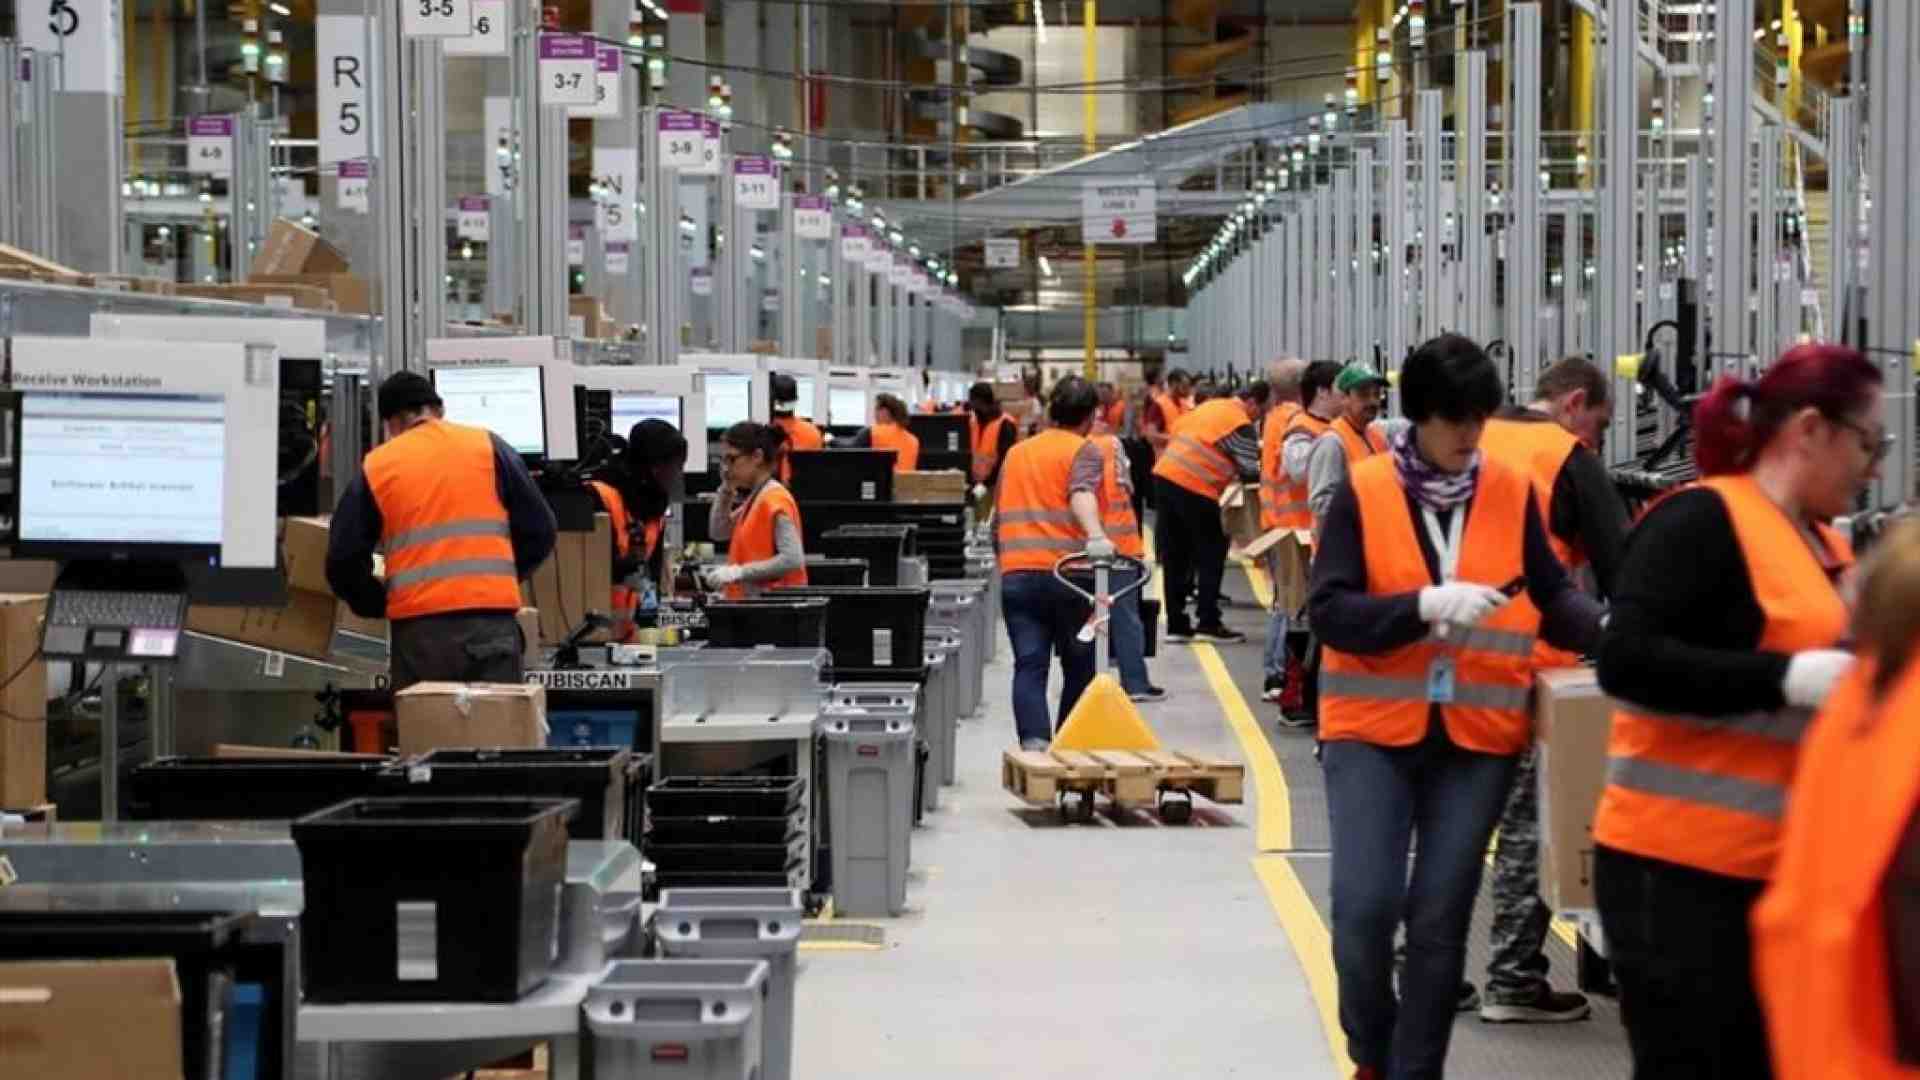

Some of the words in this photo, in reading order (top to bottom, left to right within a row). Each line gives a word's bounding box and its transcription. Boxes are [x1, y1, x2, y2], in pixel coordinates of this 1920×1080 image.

[419, 0, 453, 17] 3-5
[50, 0, 78, 36] 5
[334, 55, 361, 88] R
[554, 72, 583, 89] 3-7
[339, 103, 361, 135] 5
[671, 141, 691, 154] 3-9
[71, 372, 162, 388] Workstation
[526, 672, 628, 689] CUBISCAN
